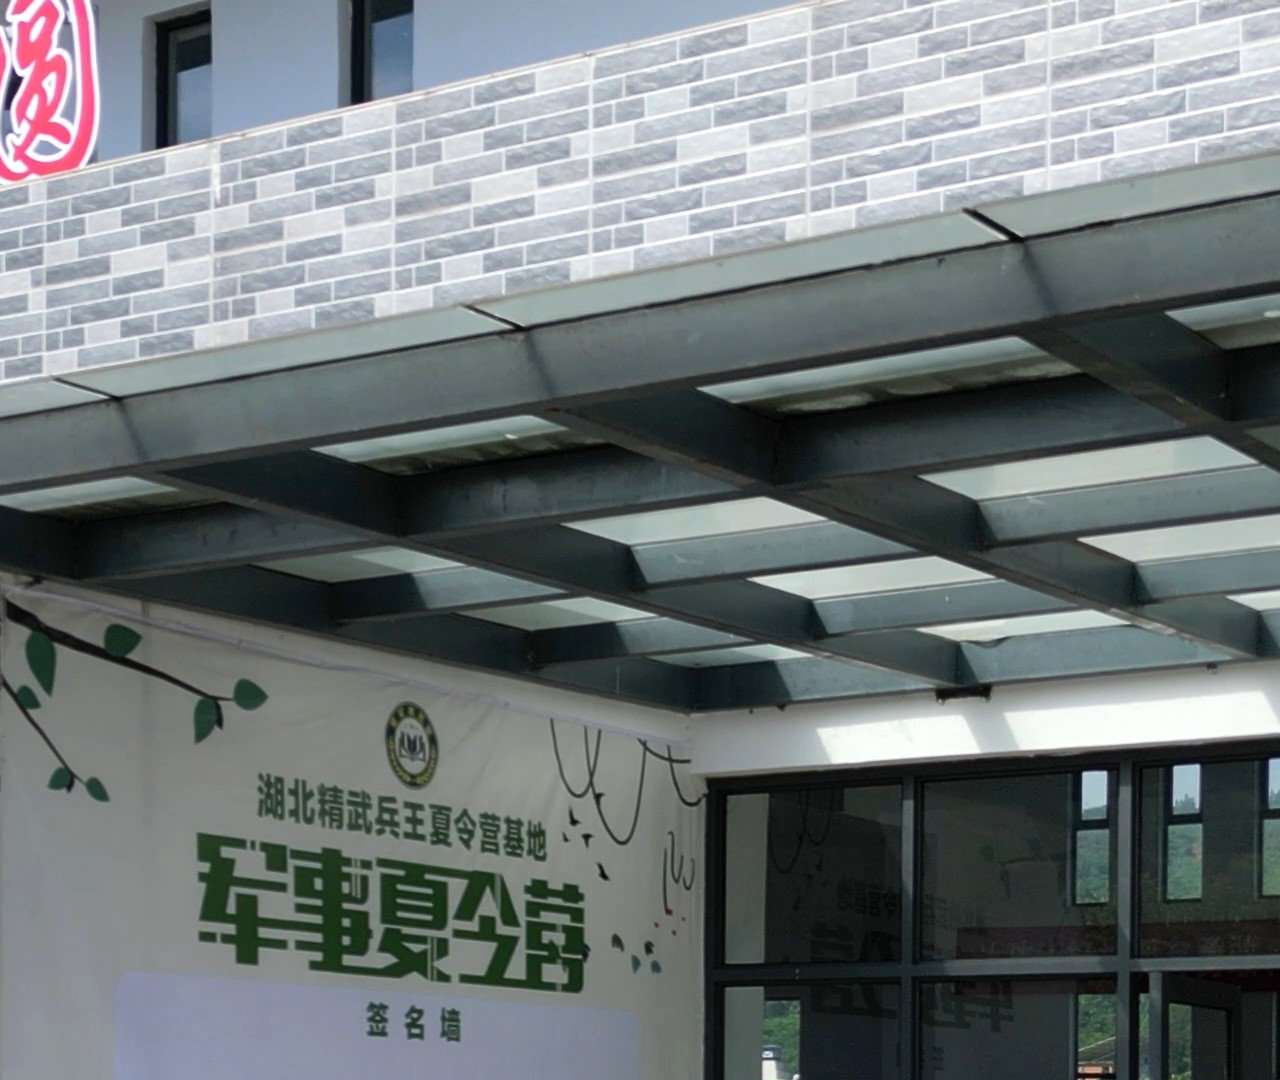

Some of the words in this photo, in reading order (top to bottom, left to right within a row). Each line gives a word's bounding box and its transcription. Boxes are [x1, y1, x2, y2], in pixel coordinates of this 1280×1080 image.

[257, 774, 547, 862] 湖北精武兵王夏令营基地
[196, 832, 586, 994] 军事夏令营
[366, 1002, 461, 1042] 签名墙
